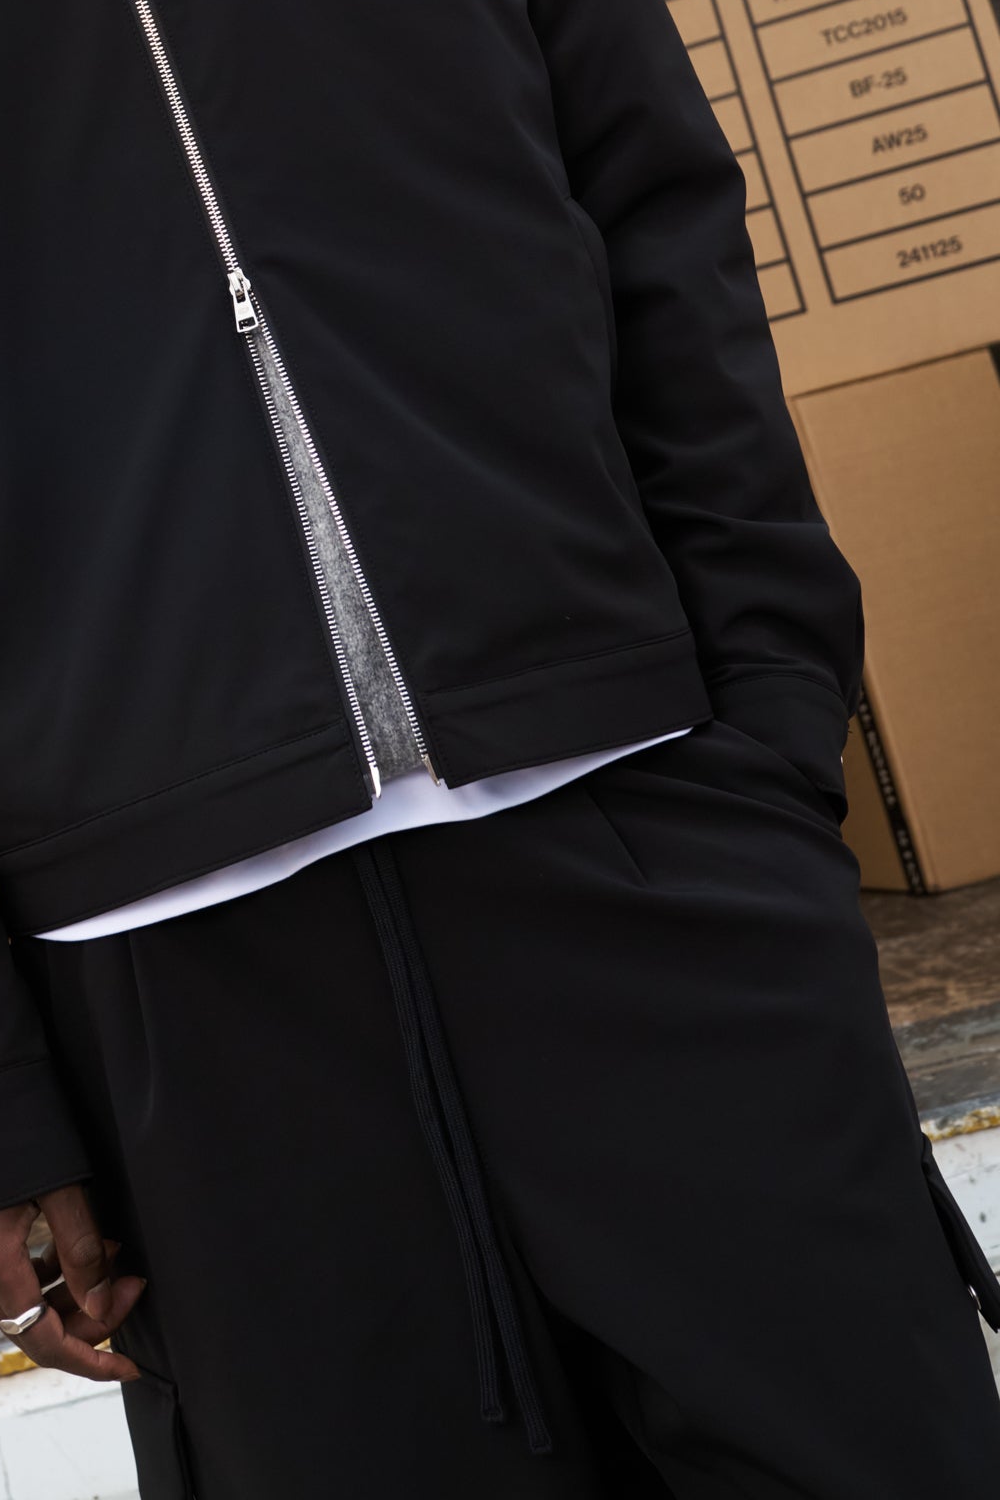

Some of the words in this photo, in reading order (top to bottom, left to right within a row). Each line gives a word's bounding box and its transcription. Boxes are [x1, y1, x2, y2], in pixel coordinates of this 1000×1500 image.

[820, 6, 908, 47] TCC2015
[849, 67, 908, 99] BF-25
[871, 123, 929, 155] AW25
[898, 183, 926, 205] 50
[896, 235, 963, 268] 241125
